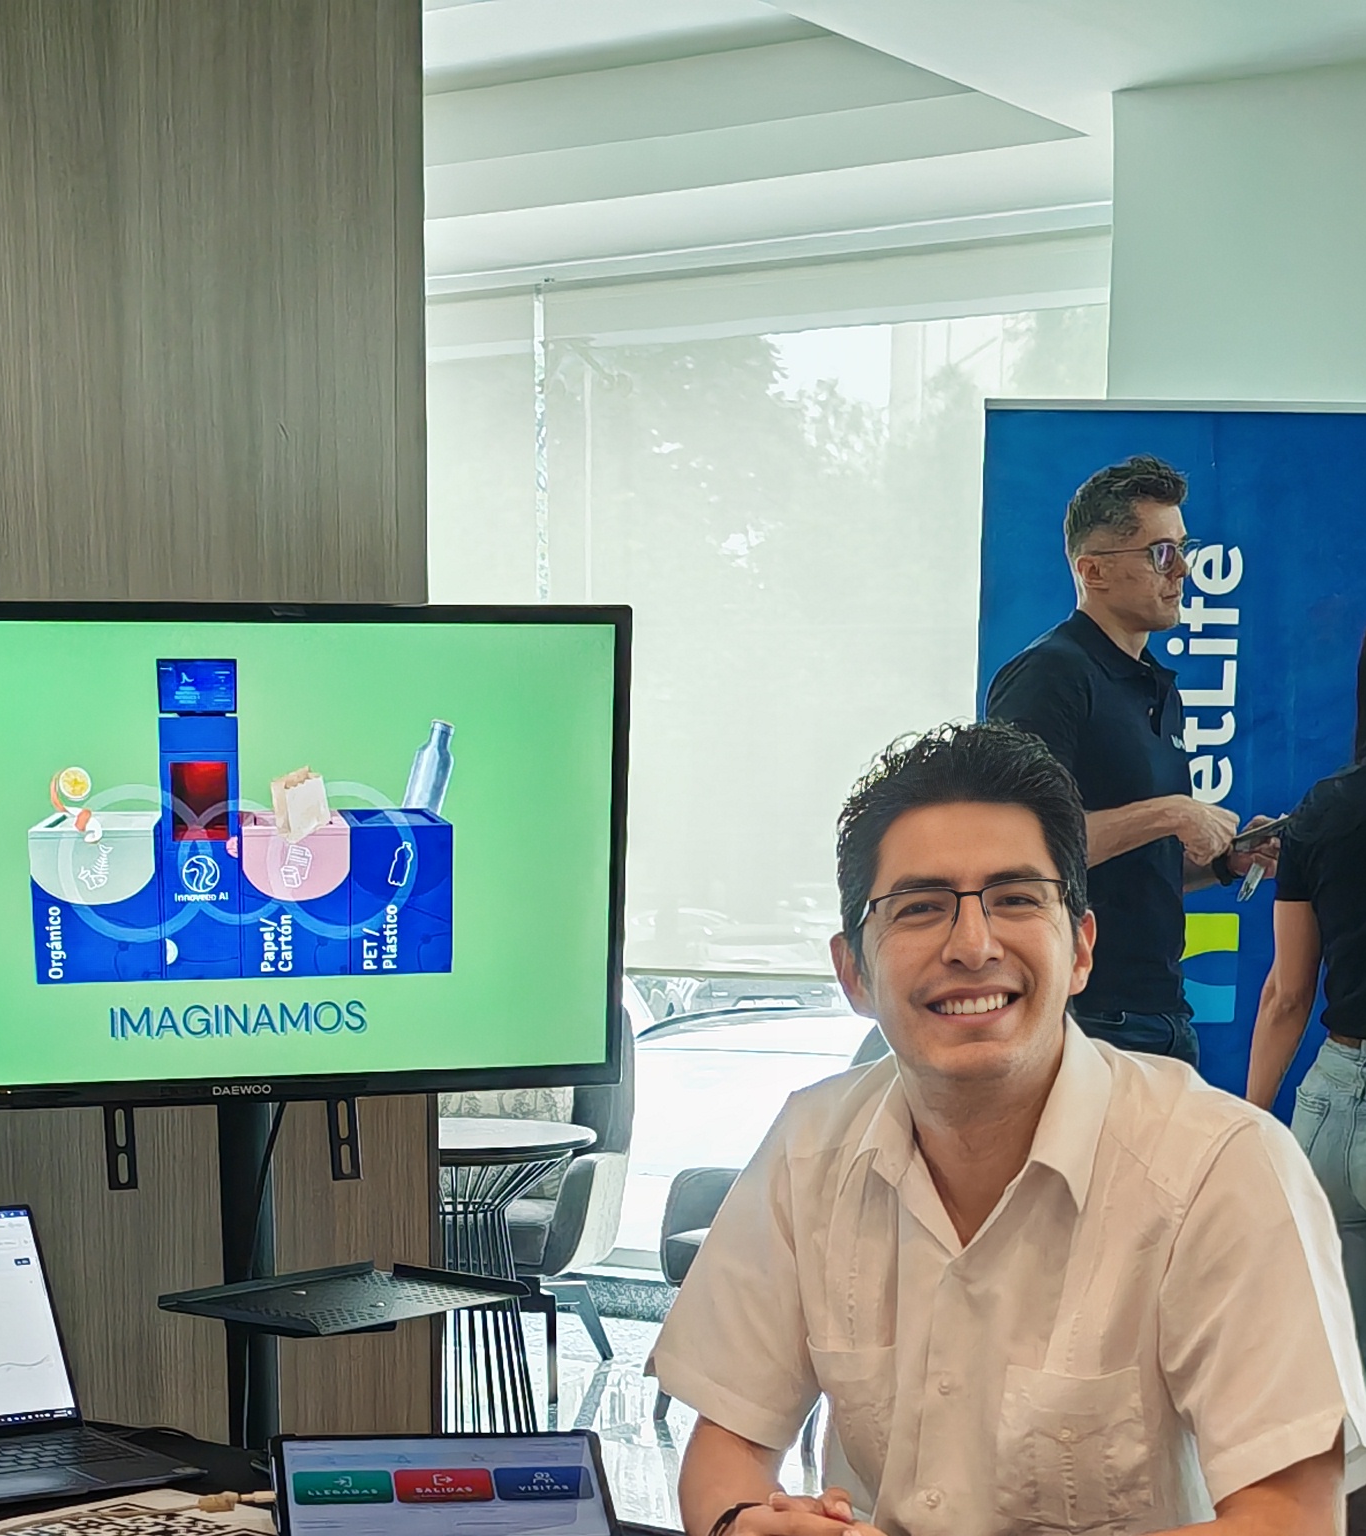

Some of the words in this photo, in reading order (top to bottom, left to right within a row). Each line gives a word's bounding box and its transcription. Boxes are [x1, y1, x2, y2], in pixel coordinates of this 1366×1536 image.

[1166, 543, 1243, 804] etLife
[45, 905, 67, 980] Orgánico
[259, 917, 278, 973] Papel/
[277, 914, 293, 972] Cartón
[363, 938, 378, 970] PET
[382, 904, 398, 969] Plástico
[109, 1000, 368, 1041] IMAGINAMOS
[212, 1084, 272, 1097] DAEWOO
[415, 1486, 473, 1494] SALIDAS
[518, 1484, 570, 1492] VISITAS
